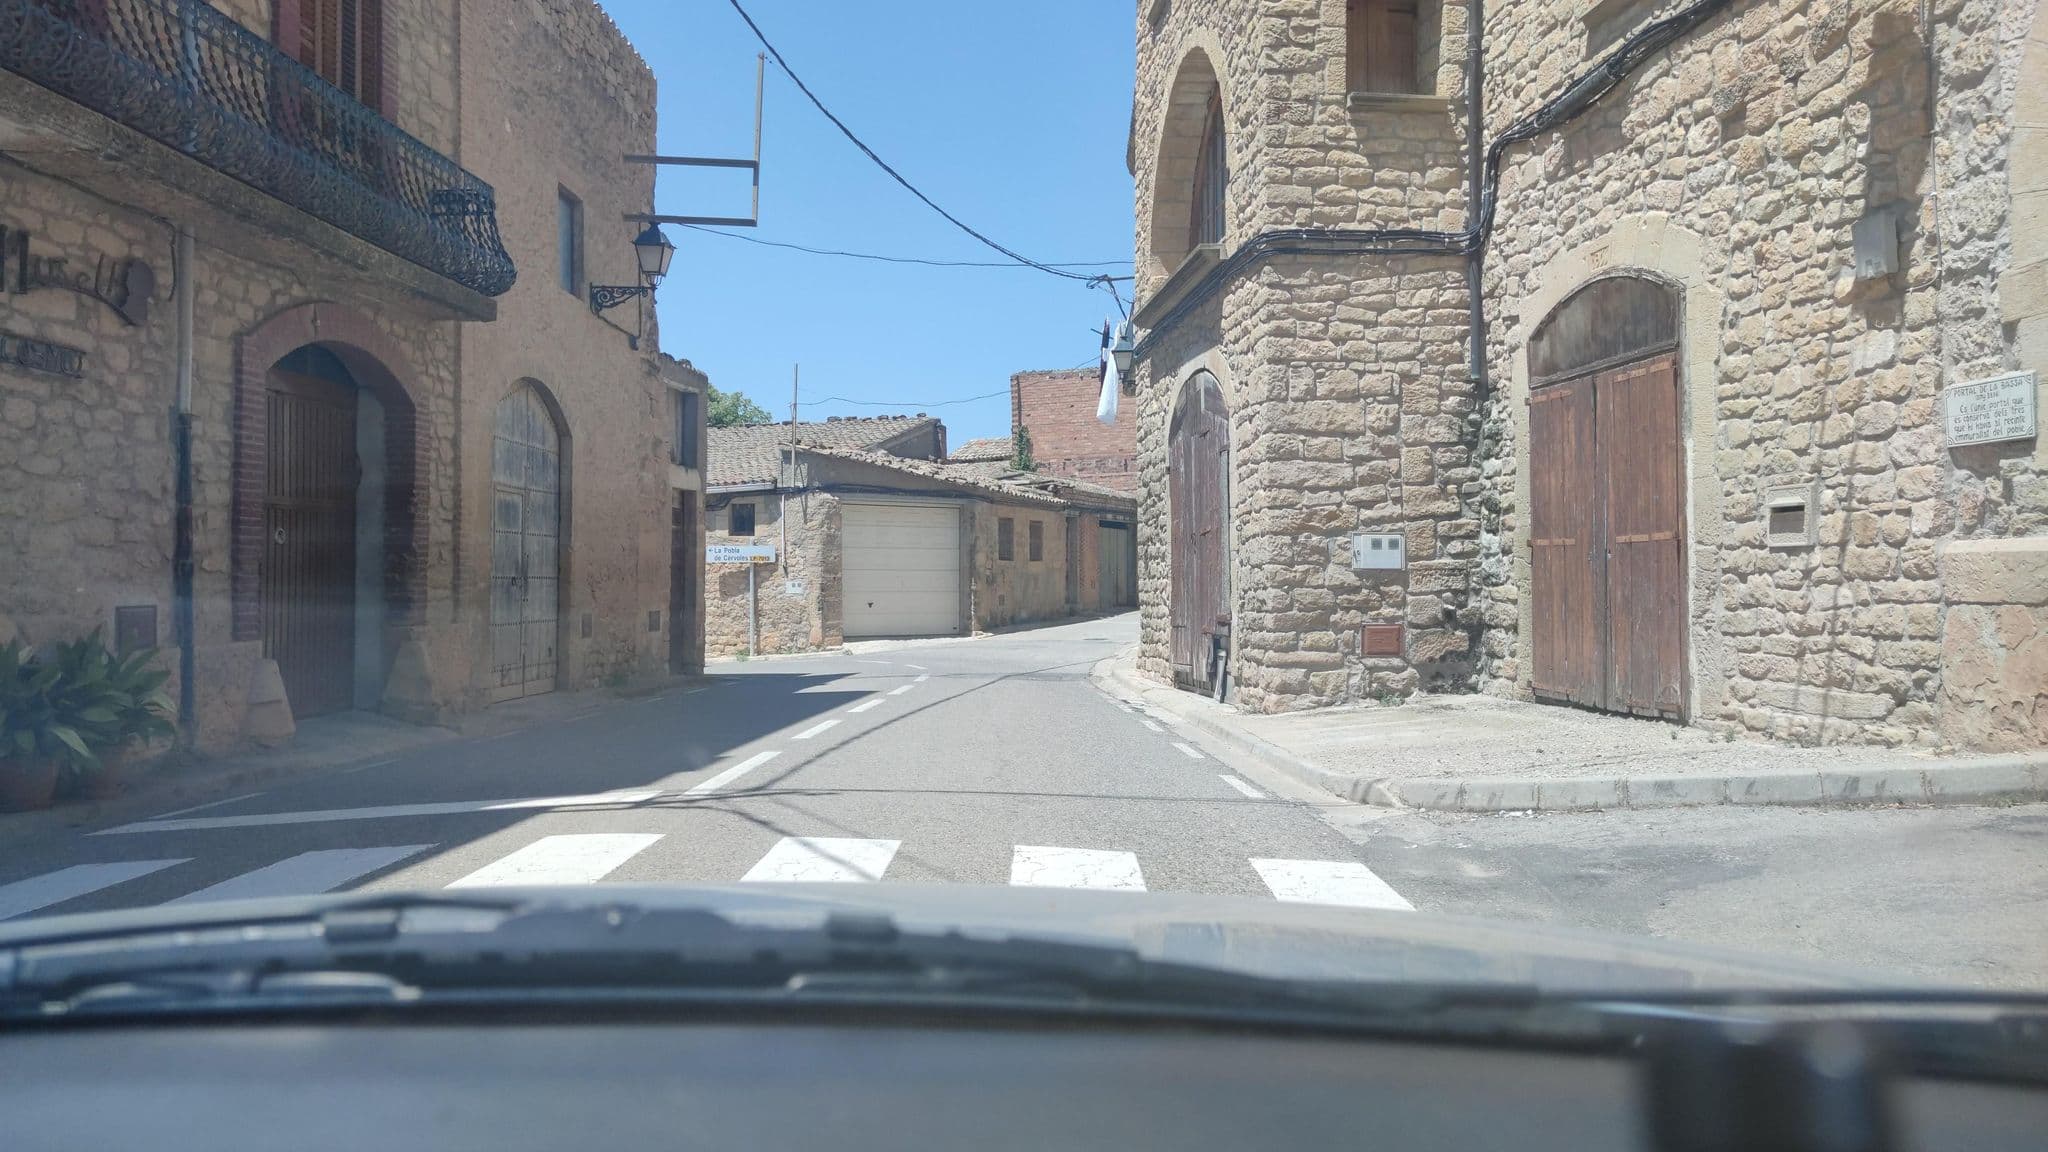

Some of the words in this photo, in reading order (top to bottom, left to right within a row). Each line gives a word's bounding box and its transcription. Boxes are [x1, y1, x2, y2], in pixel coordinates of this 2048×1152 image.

[1953, 387, 1977, 398] PORTAL
[1980, 385, 1988, 393] DE
[1989, 383, 1998, 392] LA
[2001, 380, 2023, 389] BASSA
